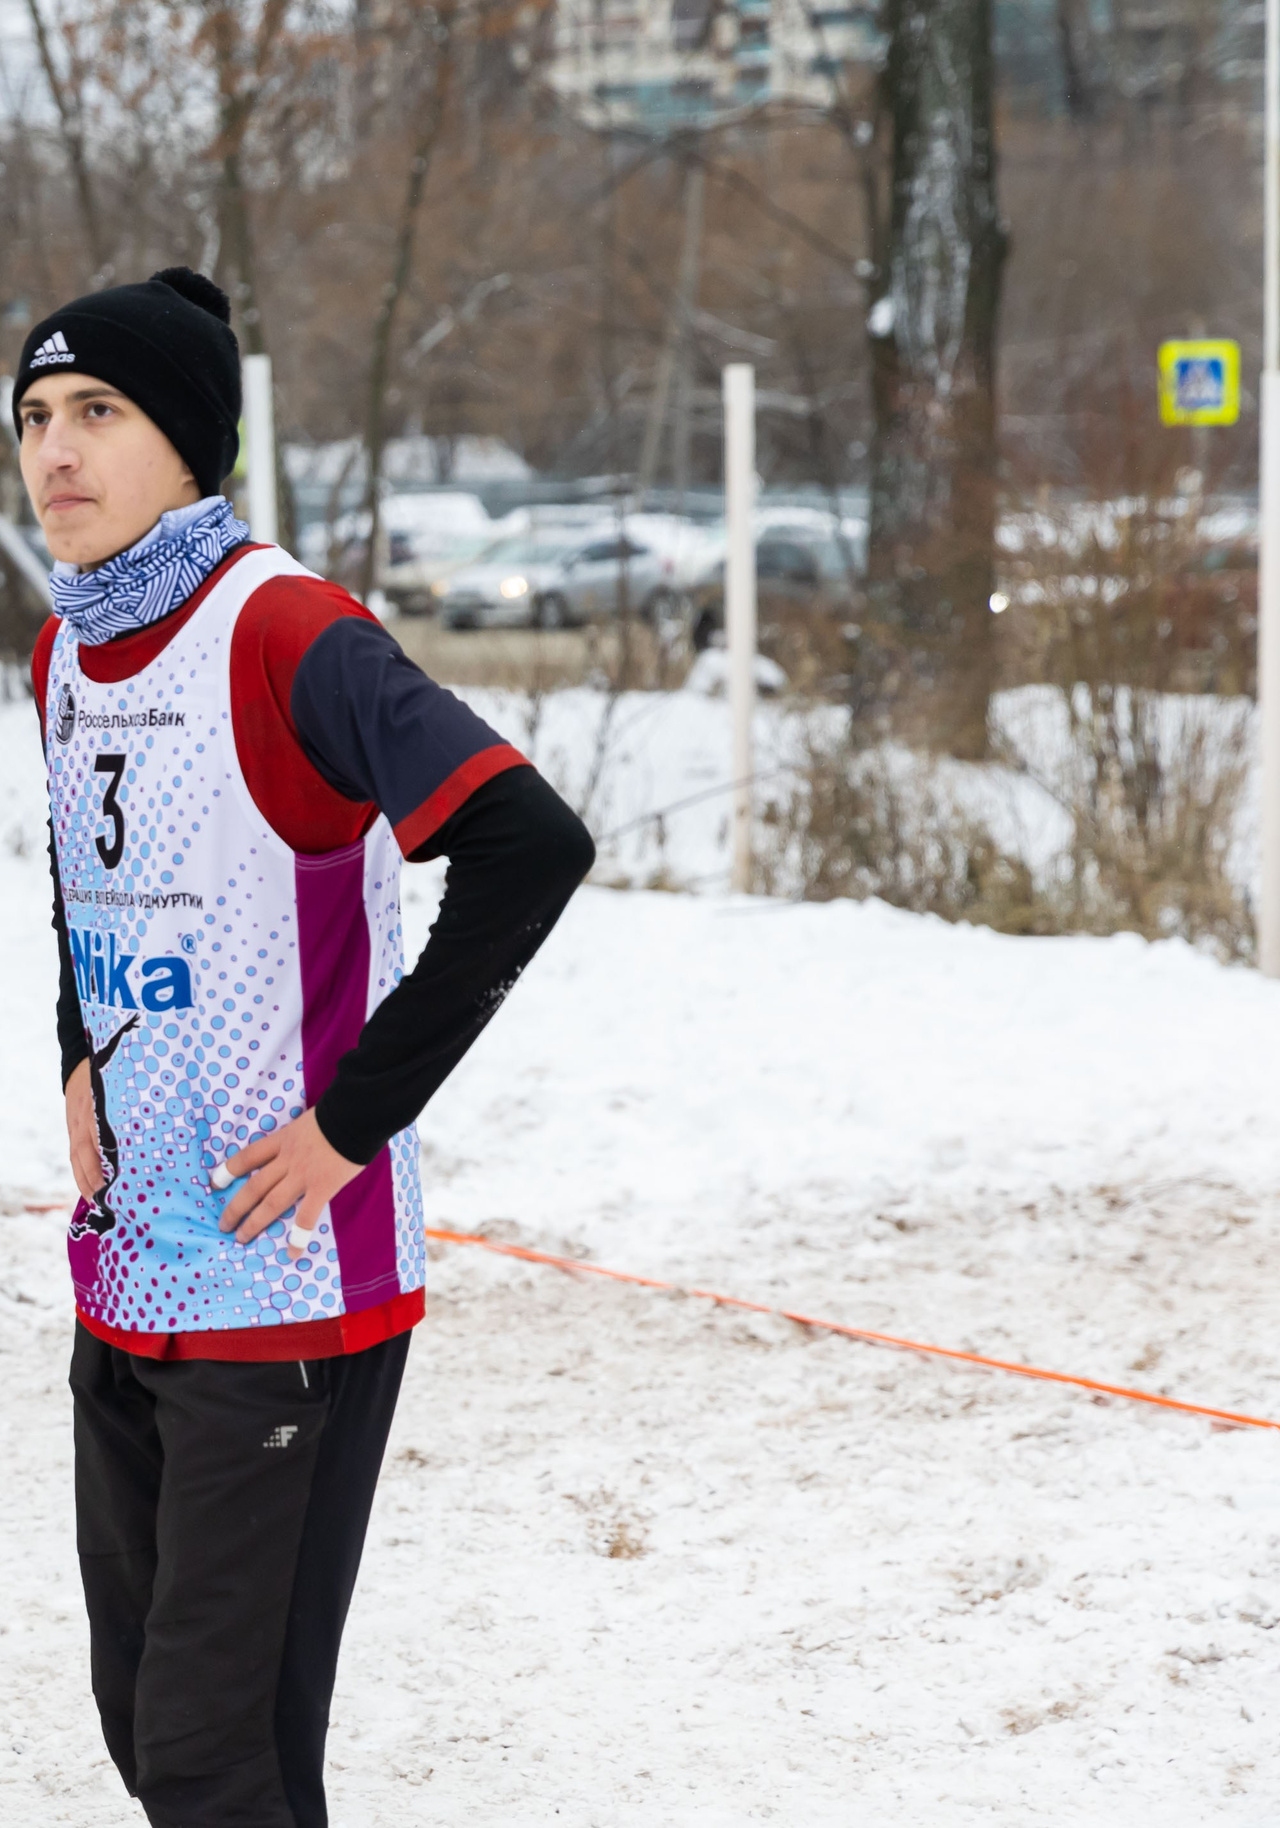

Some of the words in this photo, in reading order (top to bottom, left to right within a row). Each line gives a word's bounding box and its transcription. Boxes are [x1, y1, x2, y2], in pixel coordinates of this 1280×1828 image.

[29, 352, 76, 369] adidas
[78, 709, 186, 728] РоссельхозБанк
[94, 754, 127, 869] 3
[139, 893, 203, 910] УДМУРТИИ
